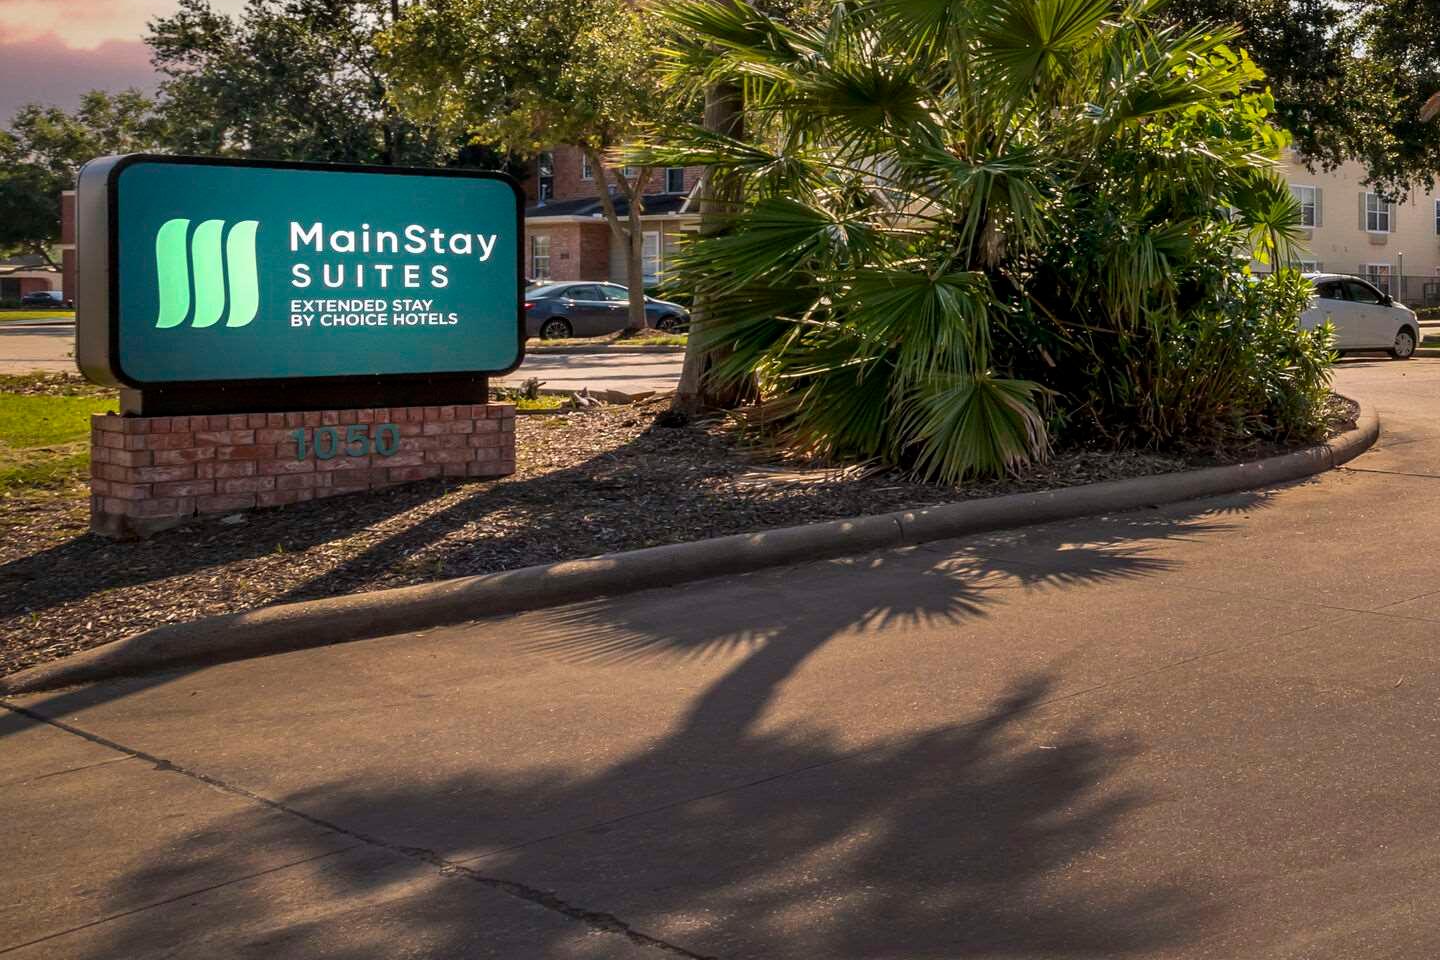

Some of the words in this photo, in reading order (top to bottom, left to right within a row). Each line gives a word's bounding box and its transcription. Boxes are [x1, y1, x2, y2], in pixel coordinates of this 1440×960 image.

[290, 221, 497, 262] MainStay
[291, 263, 449, 288] SUITES
[291, 299, 387, 312] EXTENDED
[392, 299, 433, 311] STAY
[291, 314, 315, 327] BY
[320, 313, 388, 326] CHOICE
[393, 312, 459, 325] HOTELS
[291, 423, 400, 461] 1050
